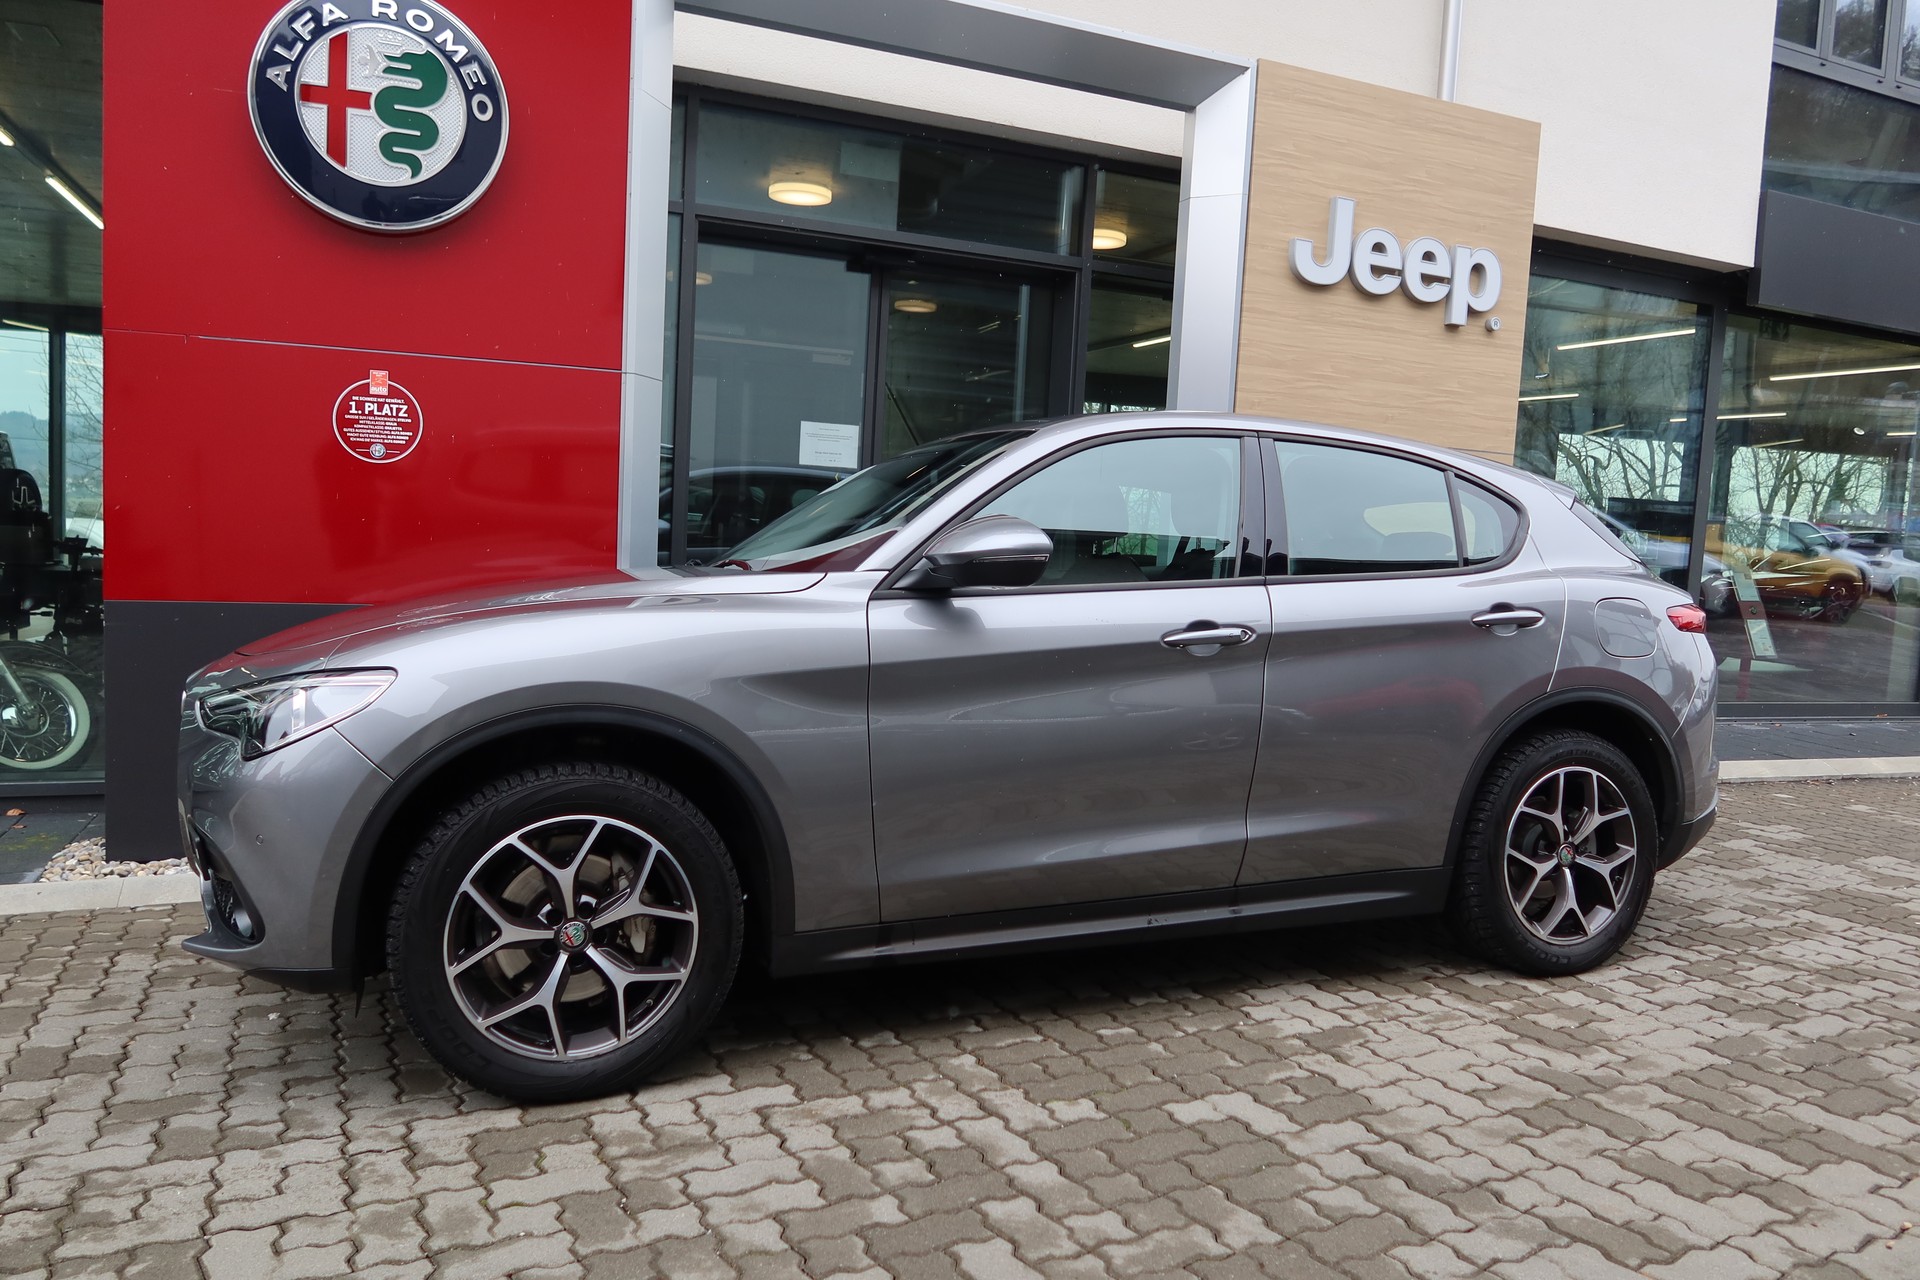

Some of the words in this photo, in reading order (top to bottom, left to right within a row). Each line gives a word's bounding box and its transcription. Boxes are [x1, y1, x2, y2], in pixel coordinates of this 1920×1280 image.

[266, 1, 349, 92] ALFA
[371, 0, 494, 122] ROMEO
[1289, 196, 1502, 327] Jeep
[349, 401, 362, 414] 1.
[365, 402, 408, 417] PLATZ
